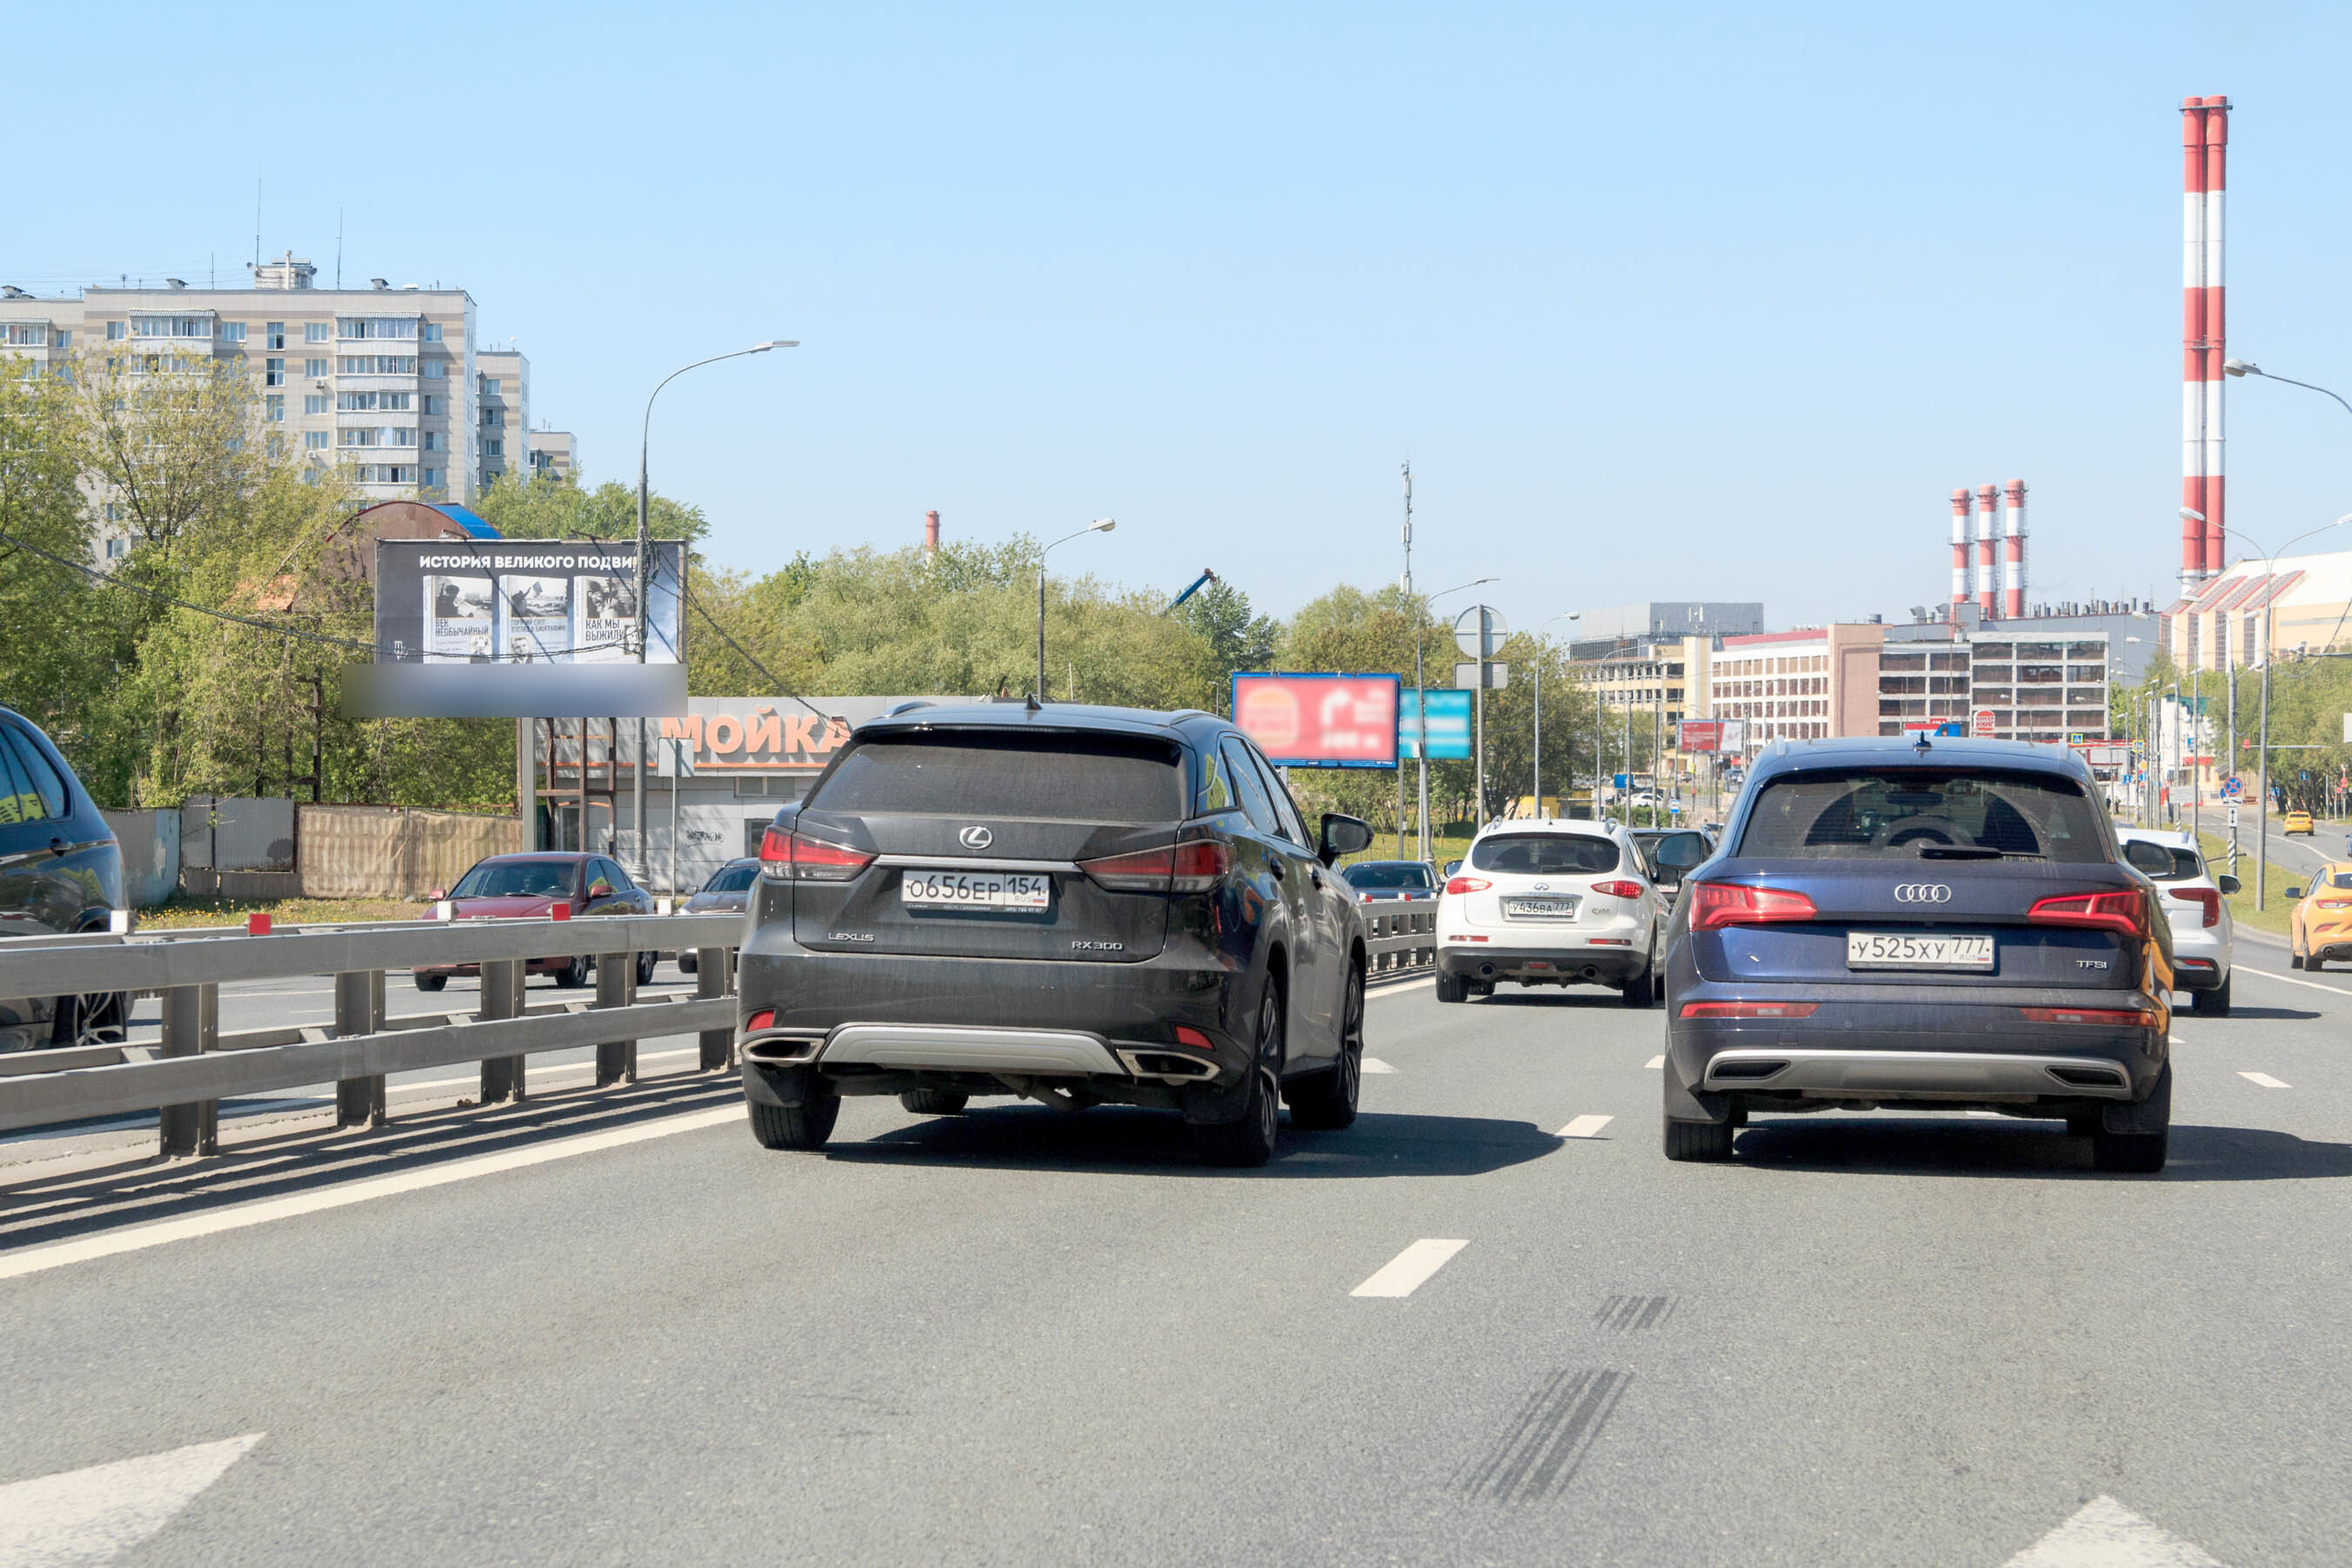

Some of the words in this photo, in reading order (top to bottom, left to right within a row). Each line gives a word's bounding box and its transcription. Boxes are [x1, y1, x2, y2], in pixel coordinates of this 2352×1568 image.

[420, 556, 491, 568] ИСТОРИЯ
[494, 556, 575, 569] ВЕЛИКОГО
[578, 556, 637, 570] ПОДВИ
[436, 618, 449, 628] ВЕК
[585, 618, 603, 630] КАК
[605, 618, 620, 629] МЫ
[436, 625, 489, 637] НЕОБЫЧАЙНЫЙ
[661, 704, 852, 754] МОЙКА
[910, 875, 1000, 901] О656ЕР
[1006, 877, 1041, 897] 154
[1014, 895, 1032, 904] RUS
[1554, 902, 1570, 911] 777
[828, 932, 874, 942] LEXUS
[1951, 937, 1986, 954] 777
[2075, 960, 2108, 970] TFSI
